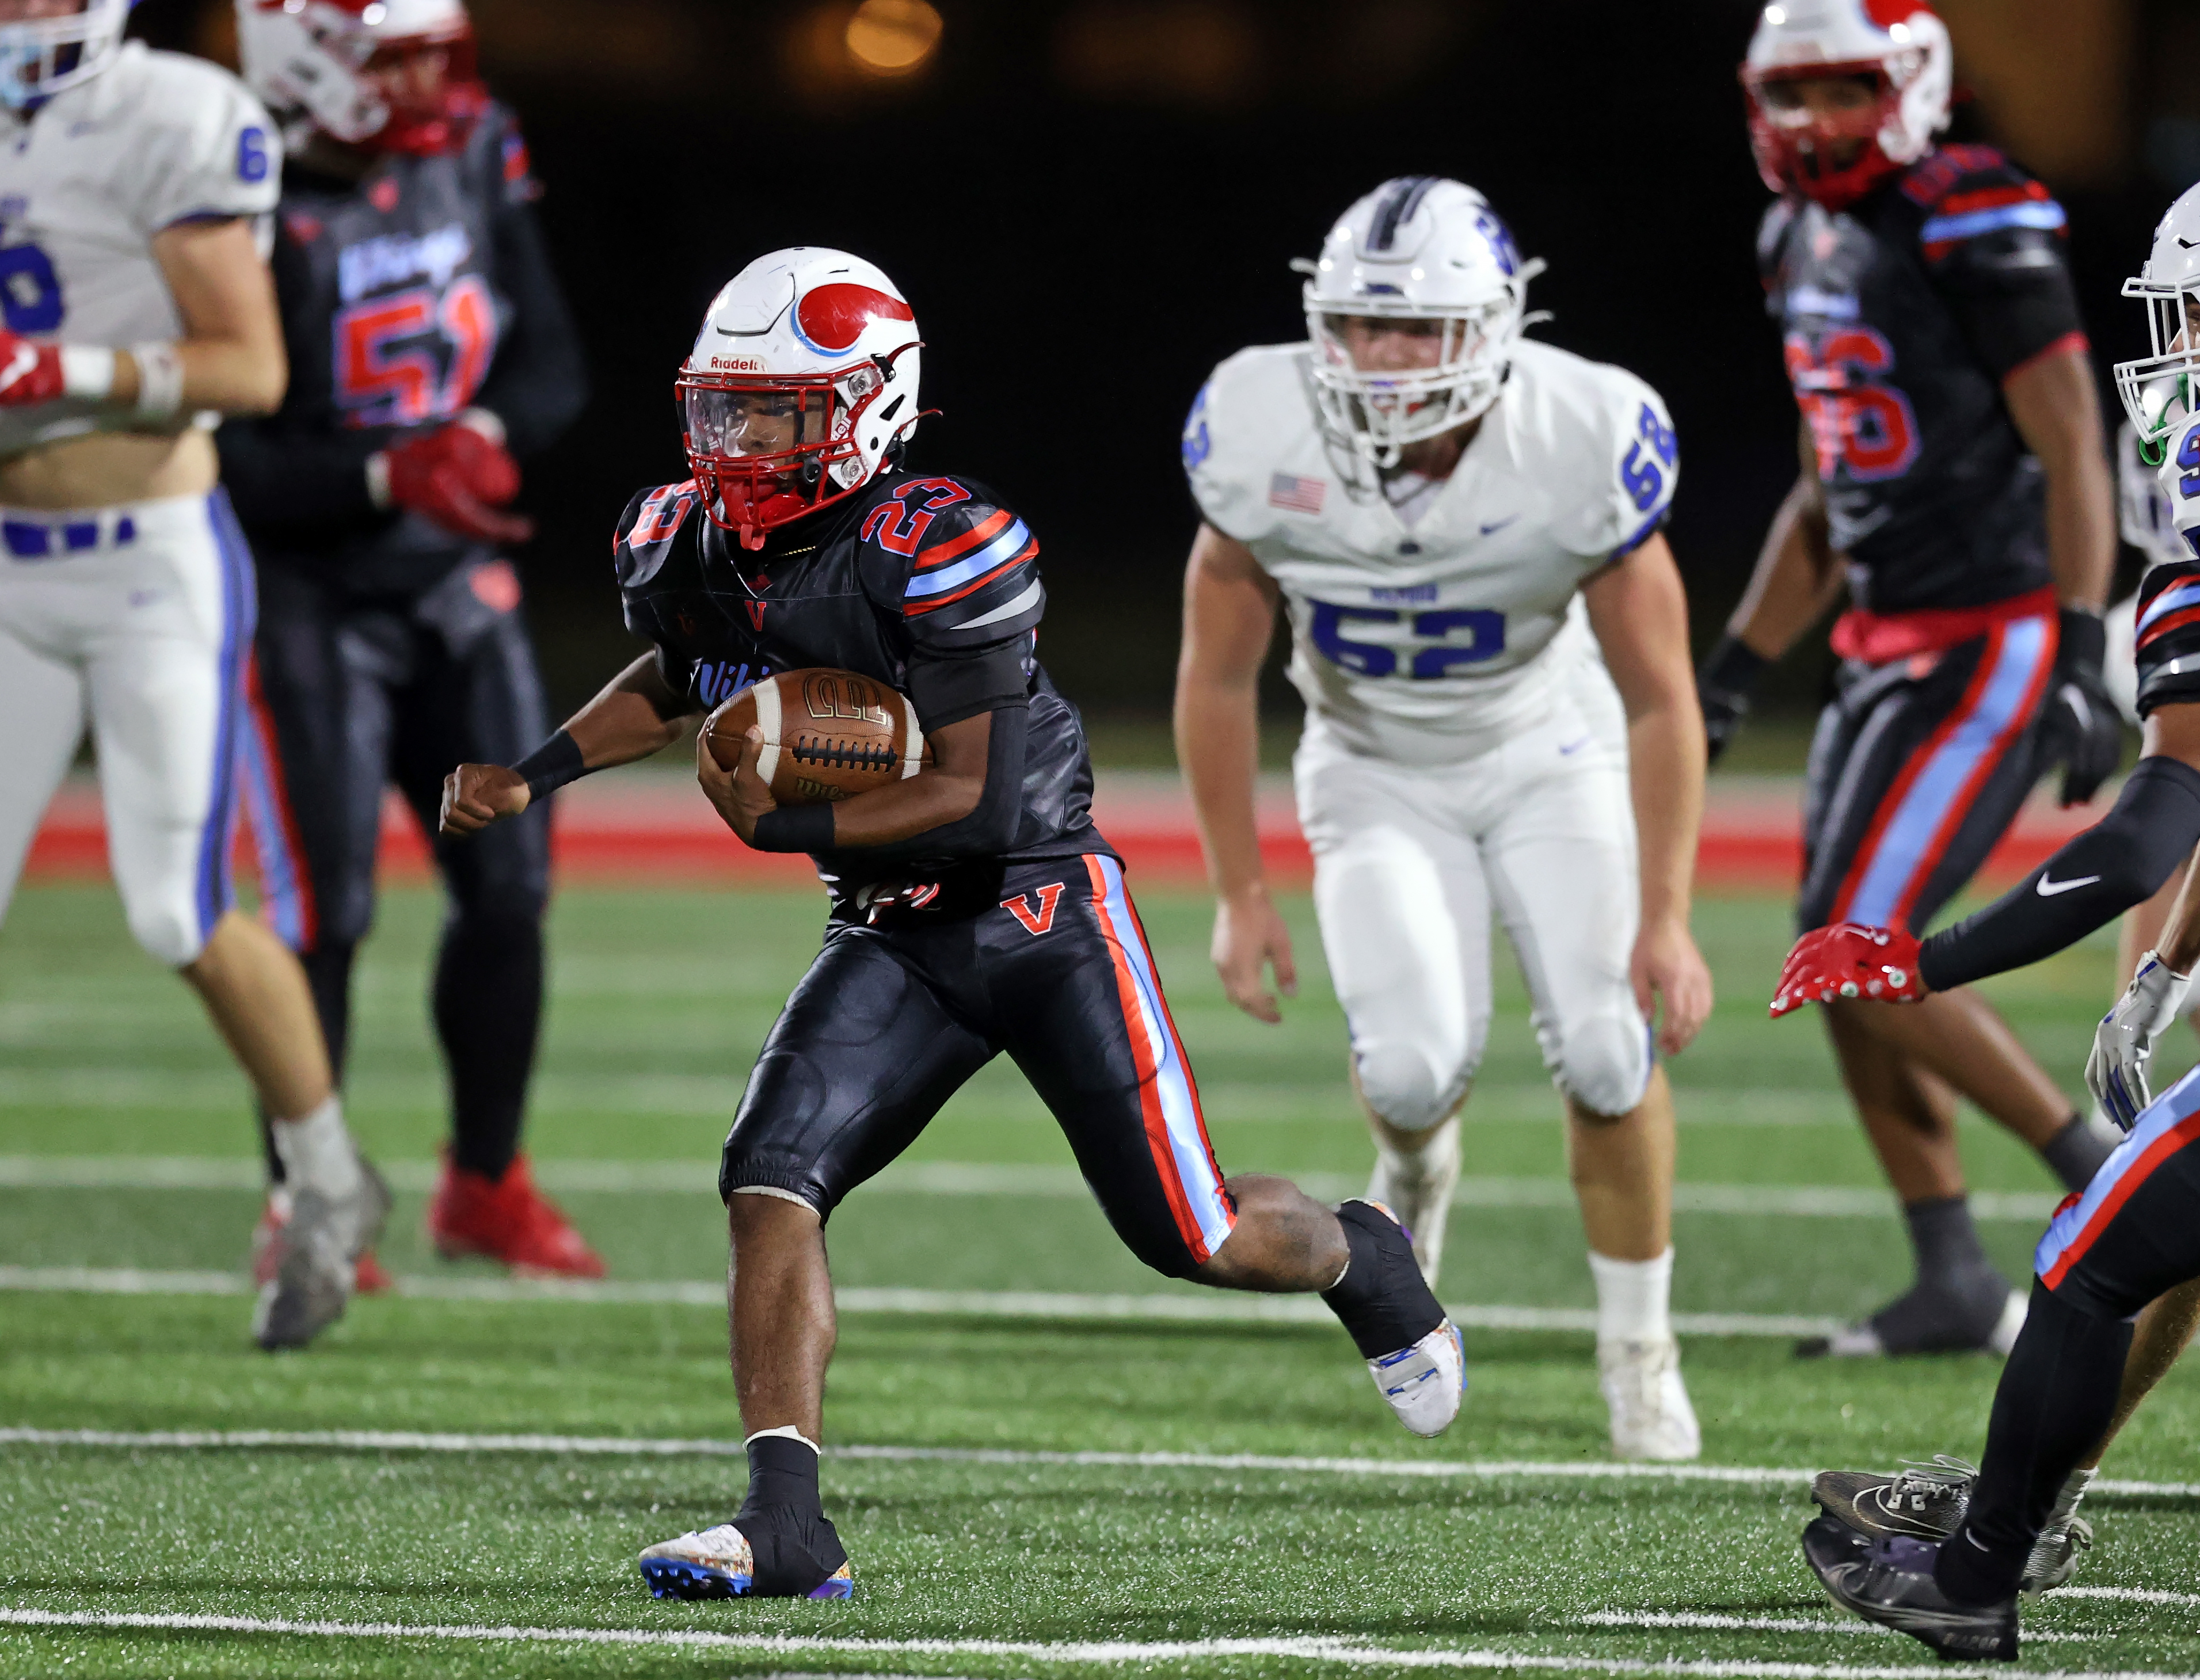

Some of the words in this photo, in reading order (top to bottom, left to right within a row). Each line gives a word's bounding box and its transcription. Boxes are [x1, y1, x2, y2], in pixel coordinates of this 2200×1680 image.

[238, 126, 268, 182] 6
[331, 275, 500, 427] 51
[860, 477, 973, 558] 23
[744, 599, 767, 631] V
[999, 882, 1065, 936] V
